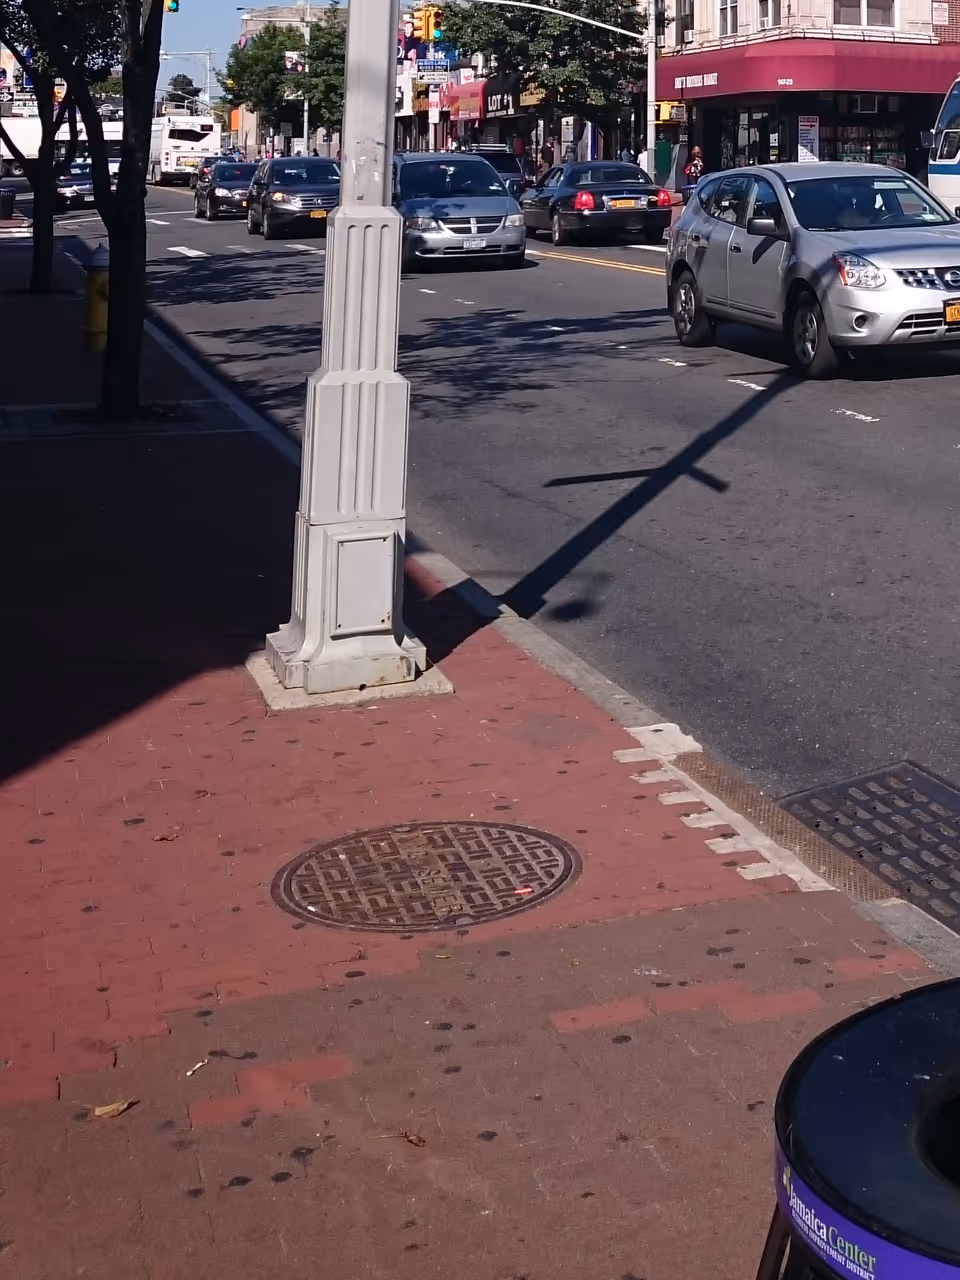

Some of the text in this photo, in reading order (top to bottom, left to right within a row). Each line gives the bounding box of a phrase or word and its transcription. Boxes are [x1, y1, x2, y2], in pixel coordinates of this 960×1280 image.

[488, 94, 502, 111] LOT
[789, 1184, 877, 1272] Jamaica Center
[809, 1228, 846, 1265] IMPROVEMENT
[846, 1260, 875, 1280] DISTRICT
